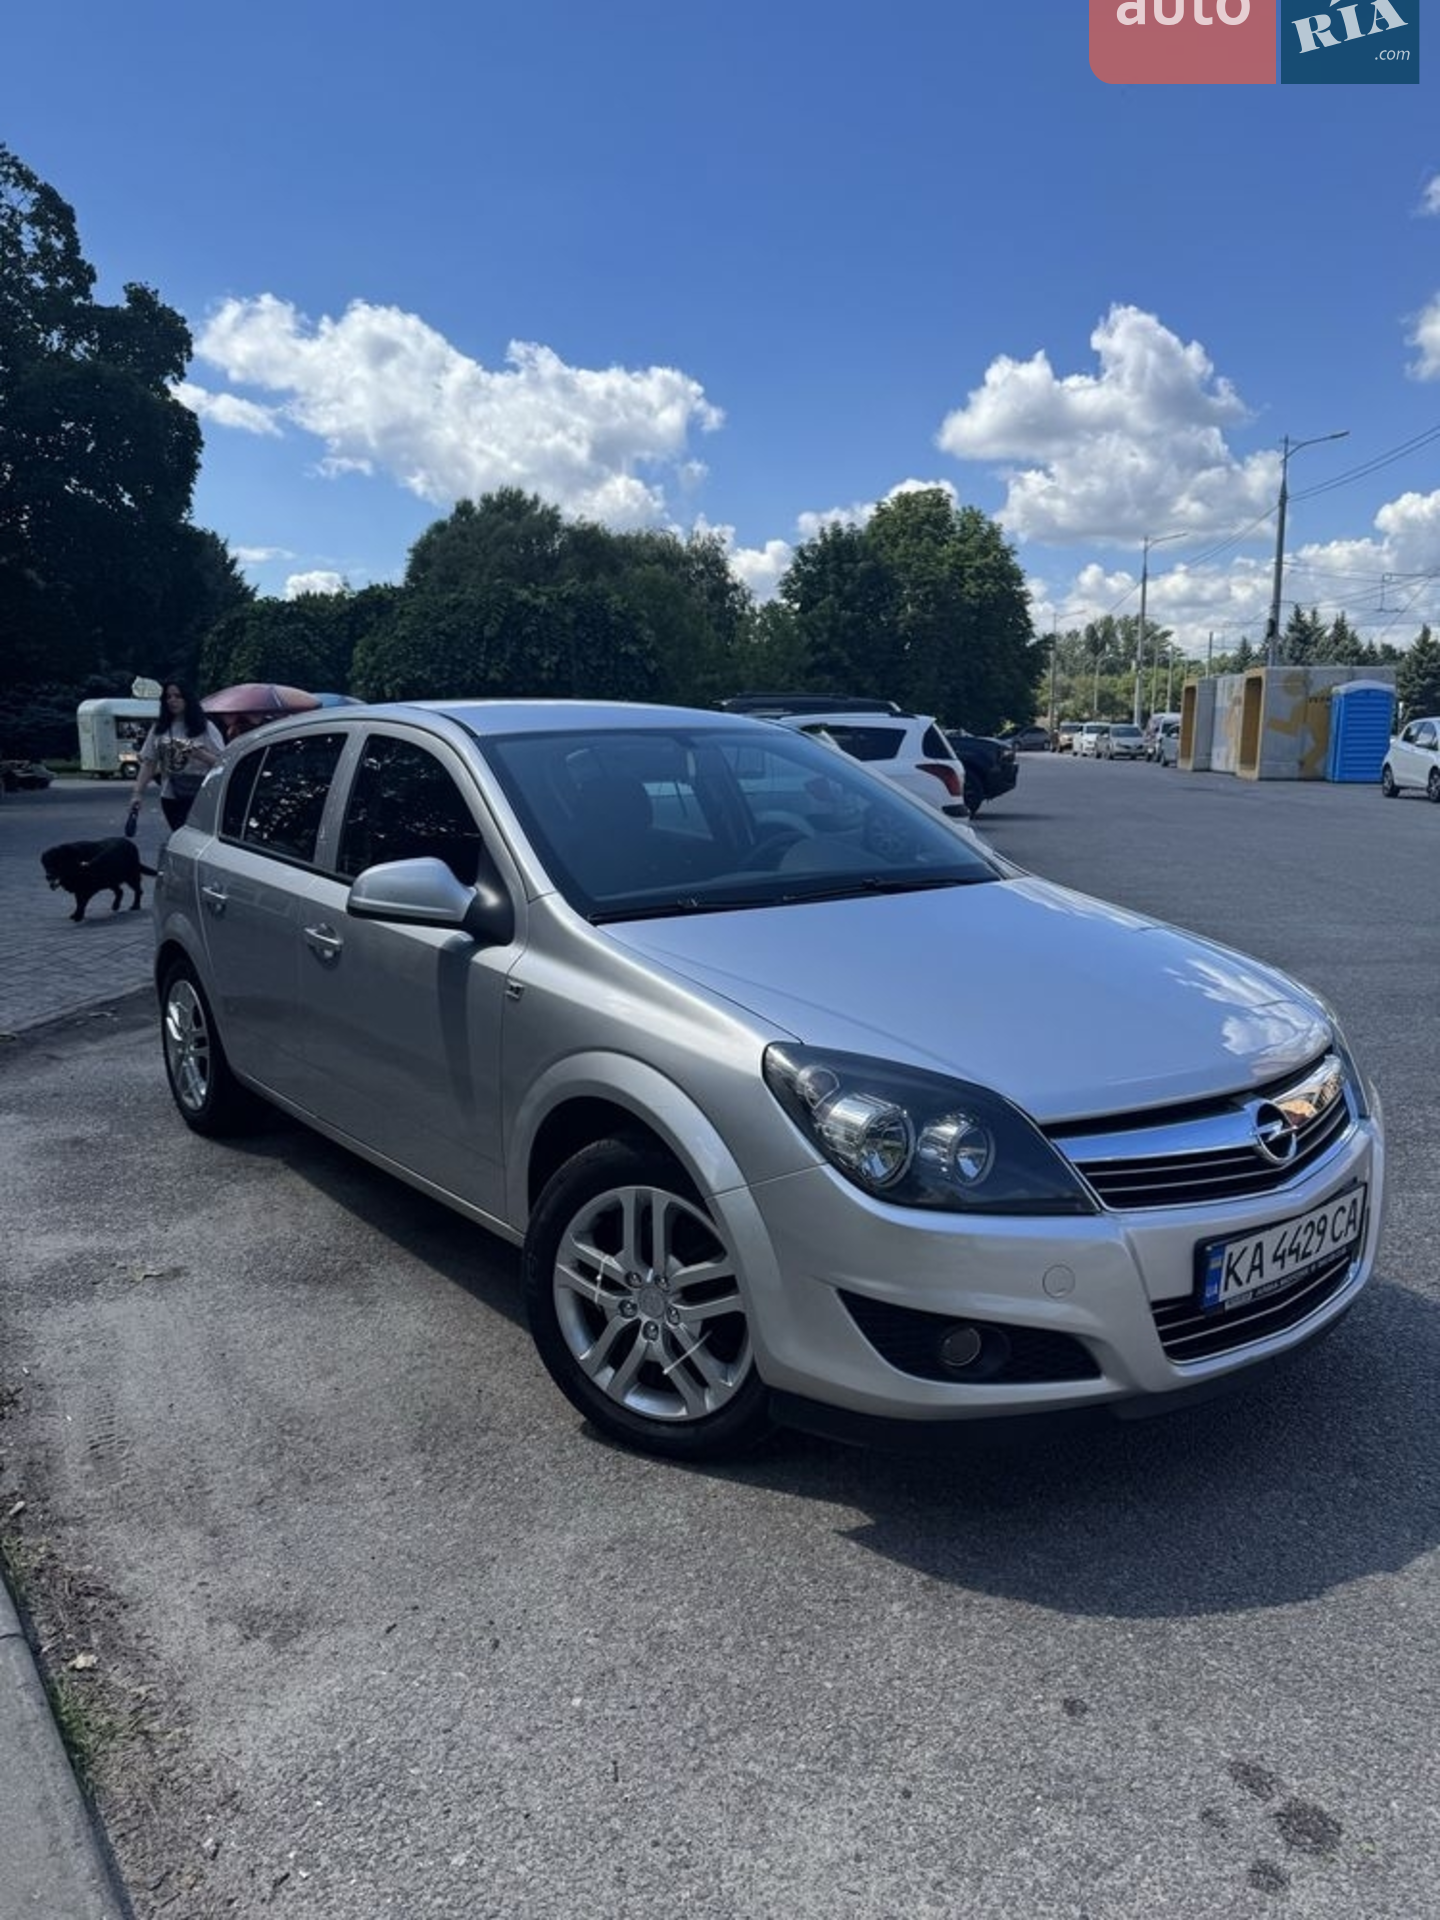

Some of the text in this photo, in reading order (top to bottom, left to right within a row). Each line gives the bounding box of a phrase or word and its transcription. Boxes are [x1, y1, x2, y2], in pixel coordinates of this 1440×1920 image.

[1223, 1240, 1264, 1292] KA
[1272, 1214, 1328, 1270] 4429
[1331, 1197, 1358, 1243] CA
